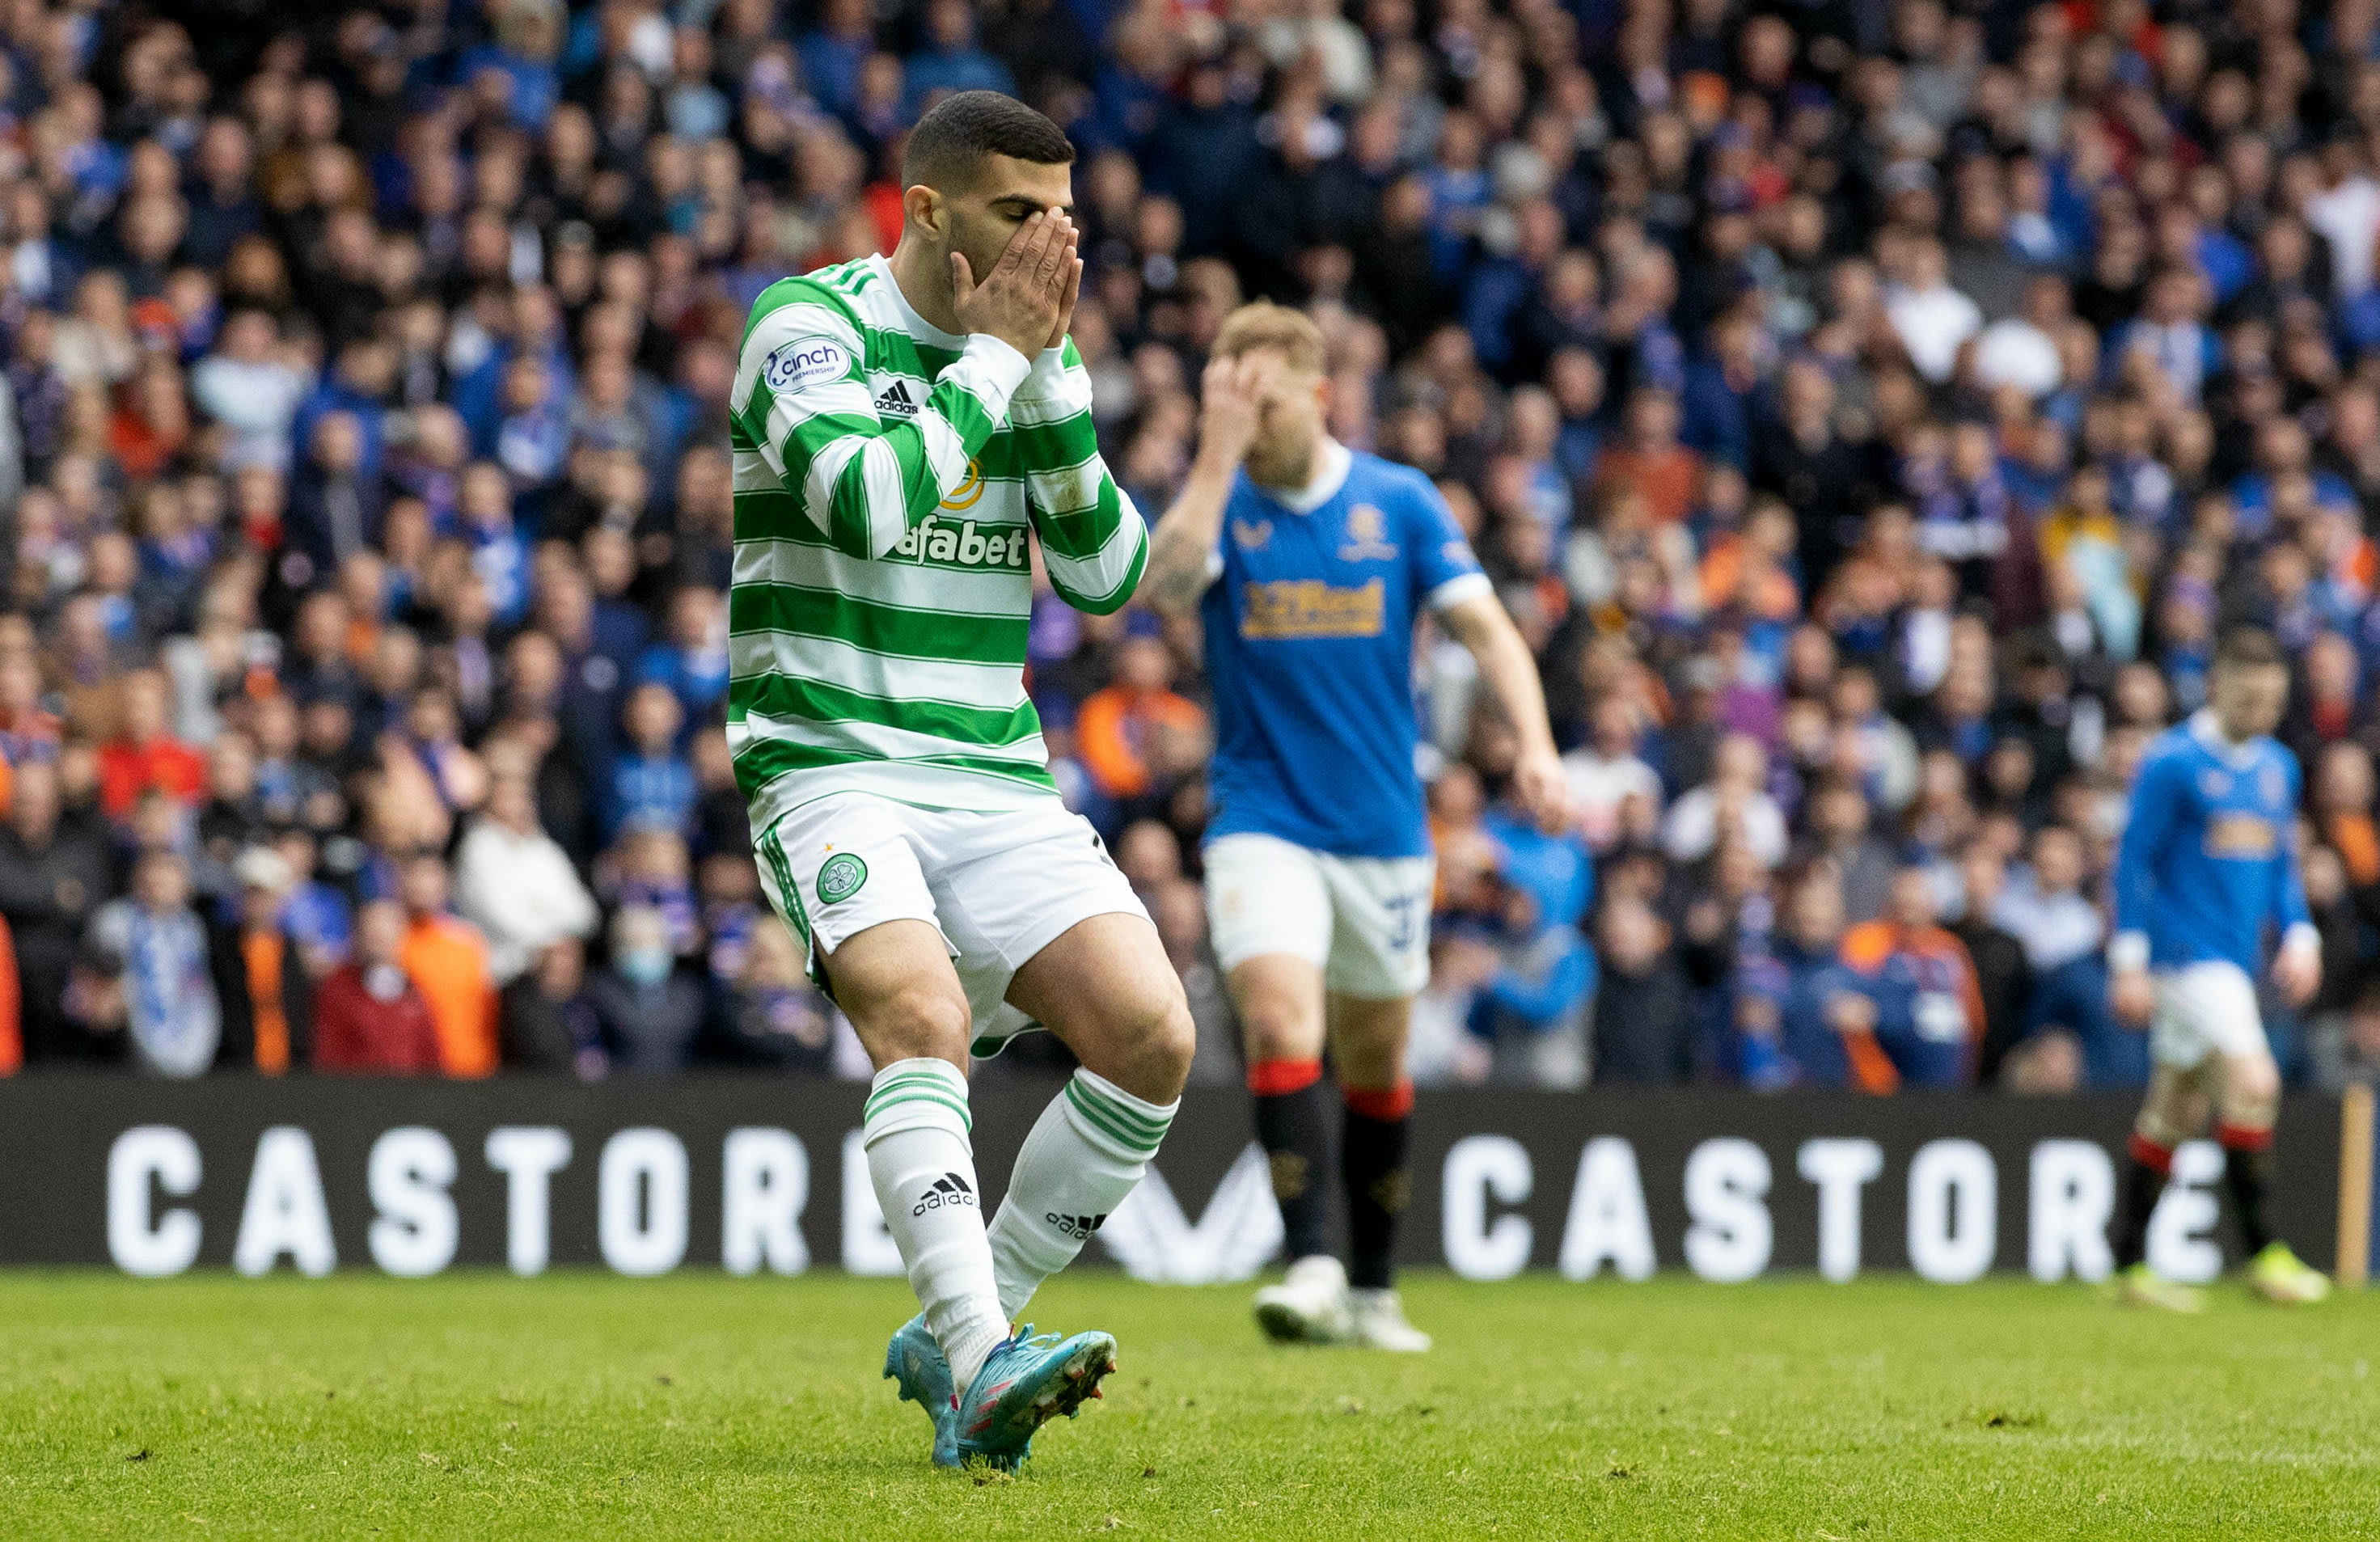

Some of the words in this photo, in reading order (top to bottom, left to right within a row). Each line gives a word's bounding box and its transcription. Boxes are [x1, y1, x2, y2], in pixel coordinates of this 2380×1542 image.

[781, 346, 839, 375] cinch
[793, 365, 836, 383] PREMIERSHIP
[874, 398, 919, 414] adidas
[894, 514, 1025, 567] afabet
[913, 1192, 979, 1216] adida
[1442, 1135, 2226, 1283] CASTORE
[1046, 1212, 1089, 1240] adid
